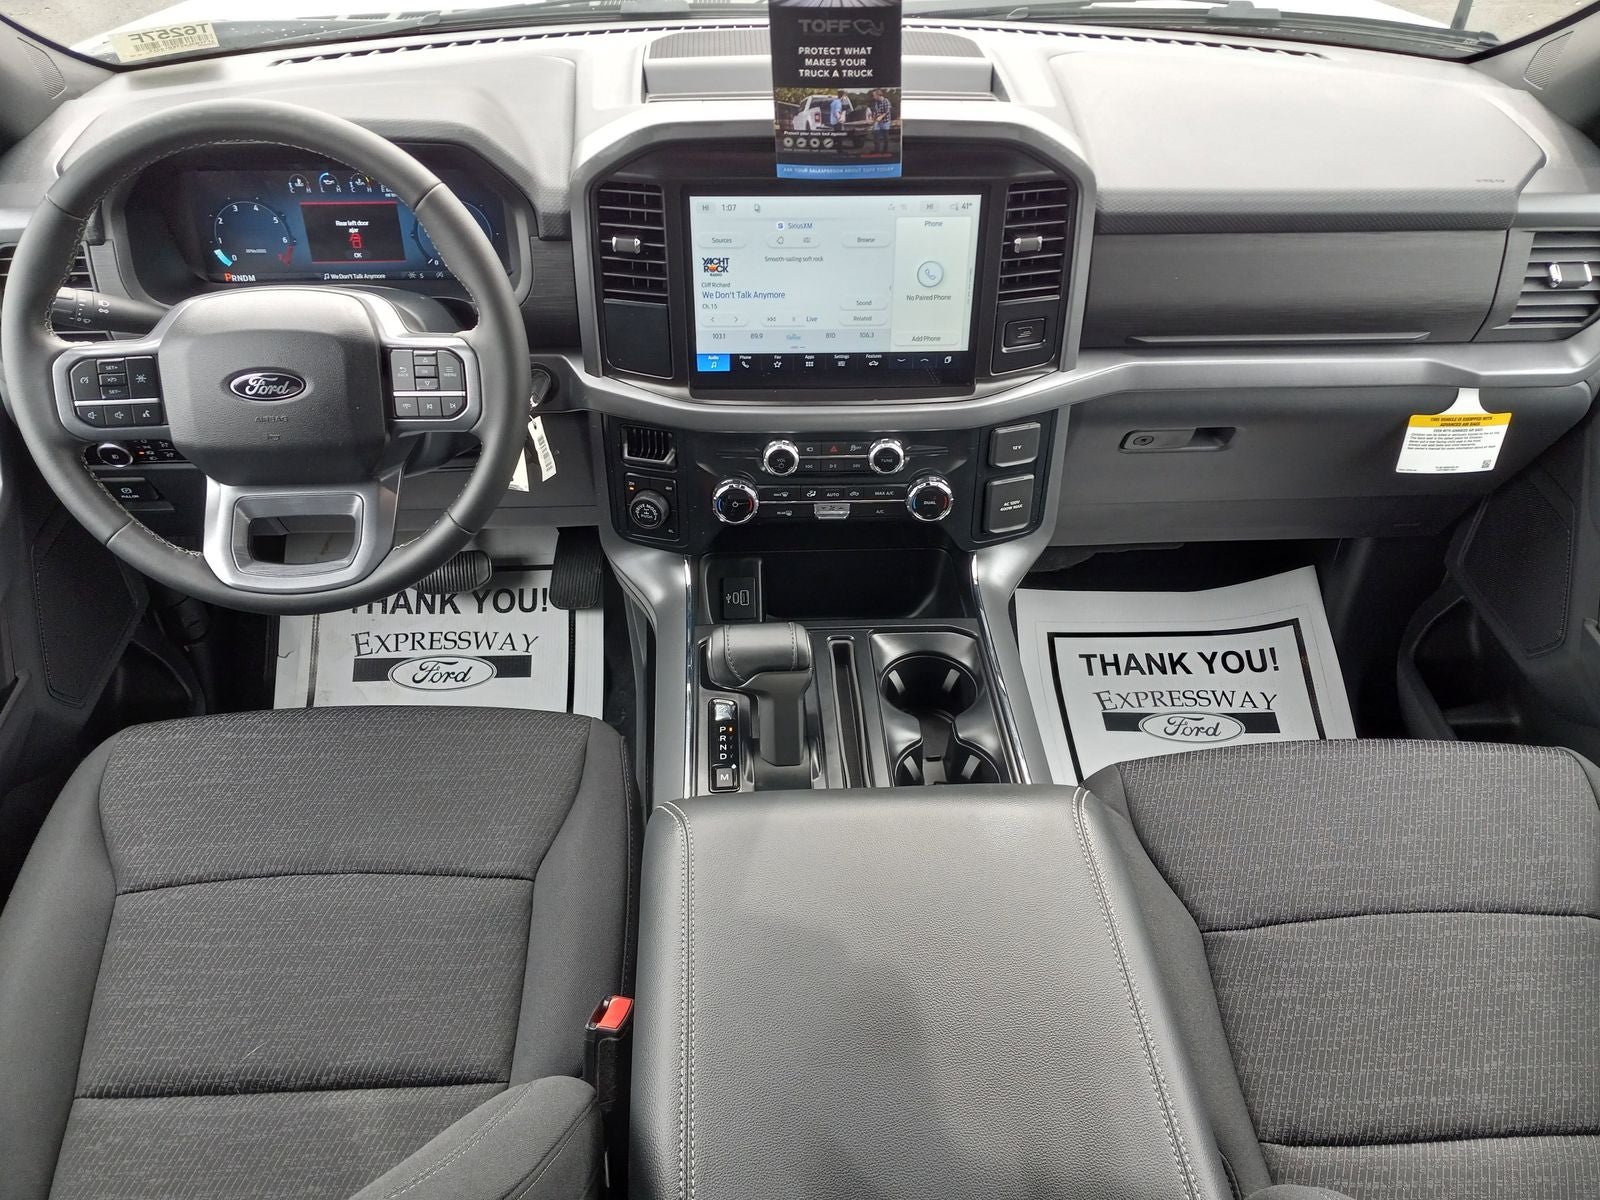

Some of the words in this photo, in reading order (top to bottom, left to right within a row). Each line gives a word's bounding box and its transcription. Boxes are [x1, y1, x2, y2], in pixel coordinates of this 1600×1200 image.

[798, 20, 850, 32] TOFF
[702, 258, 730, 266] YACHT
[754, 292, 785, 300] Anymore
[245, 376, 290, 395] Ford
[352, 591, 462, 615] HANK
[470, 588, 548, 614] YOU!
[351, 631, 540, 658] EXPRESSWAY
[412, 660, 474, 684] Ford
[1078, 652, 1193, 677] THANK
[1197, 646, 1280, 674] YOU!
[1092, 689, 1278, 712] EXPRESSWAY
[1163, 716, 1222, 738] Ford
